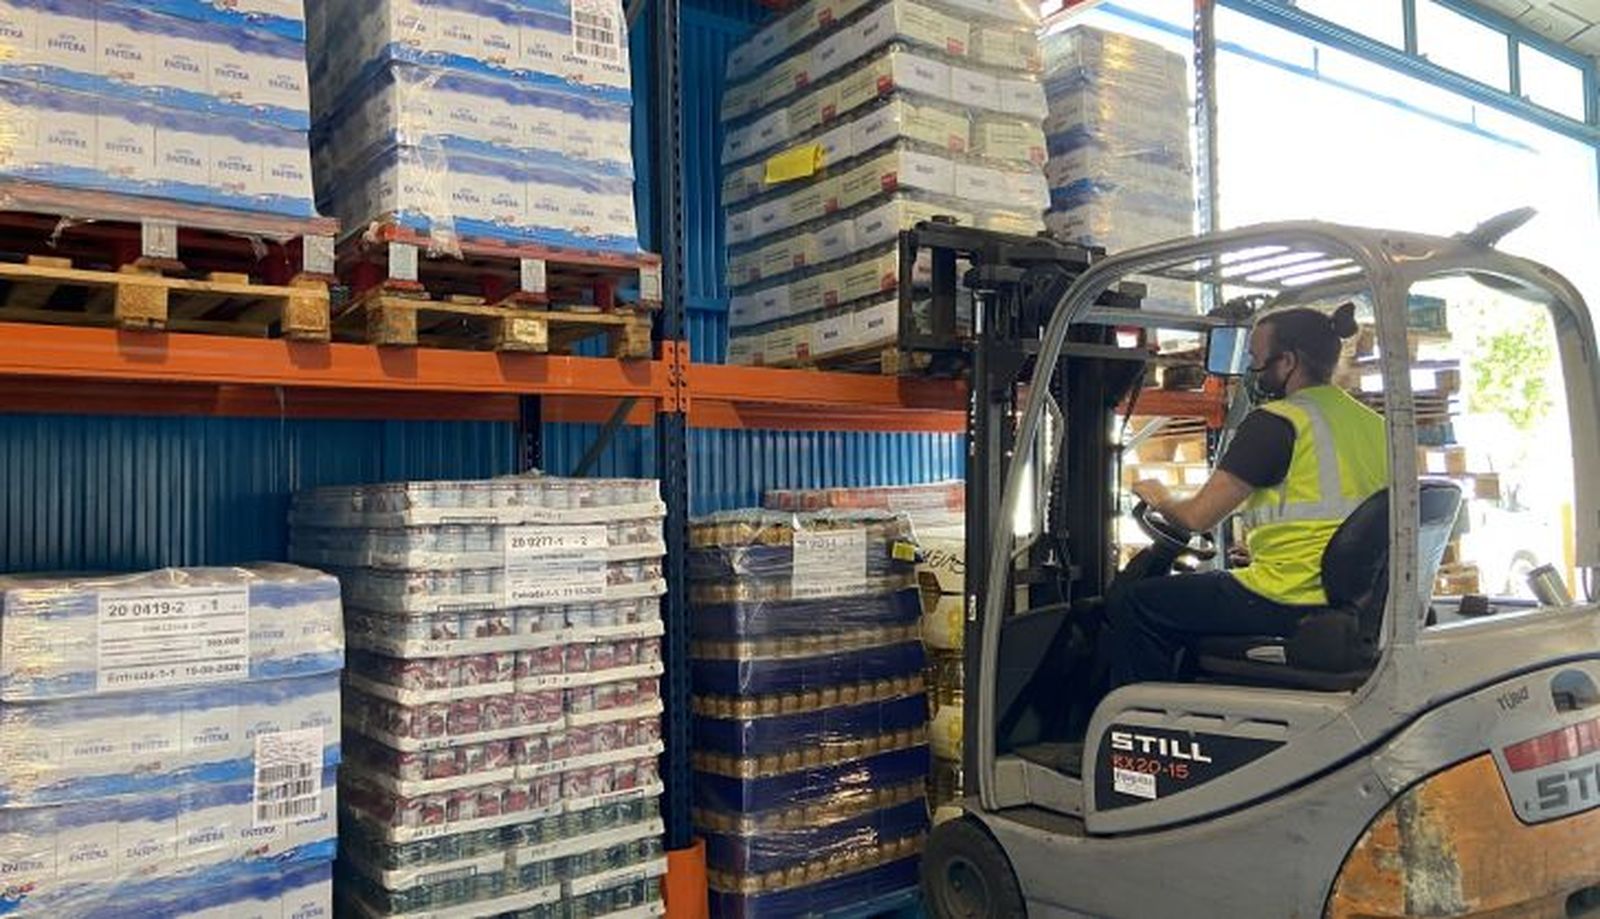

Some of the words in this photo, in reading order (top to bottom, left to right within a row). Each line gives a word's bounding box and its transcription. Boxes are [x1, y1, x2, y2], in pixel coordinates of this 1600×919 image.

[108, 604, 128, 617] 20
[132, 602, 186, 616] 0419-2
[1111, 731, 1212, 763] STILL
